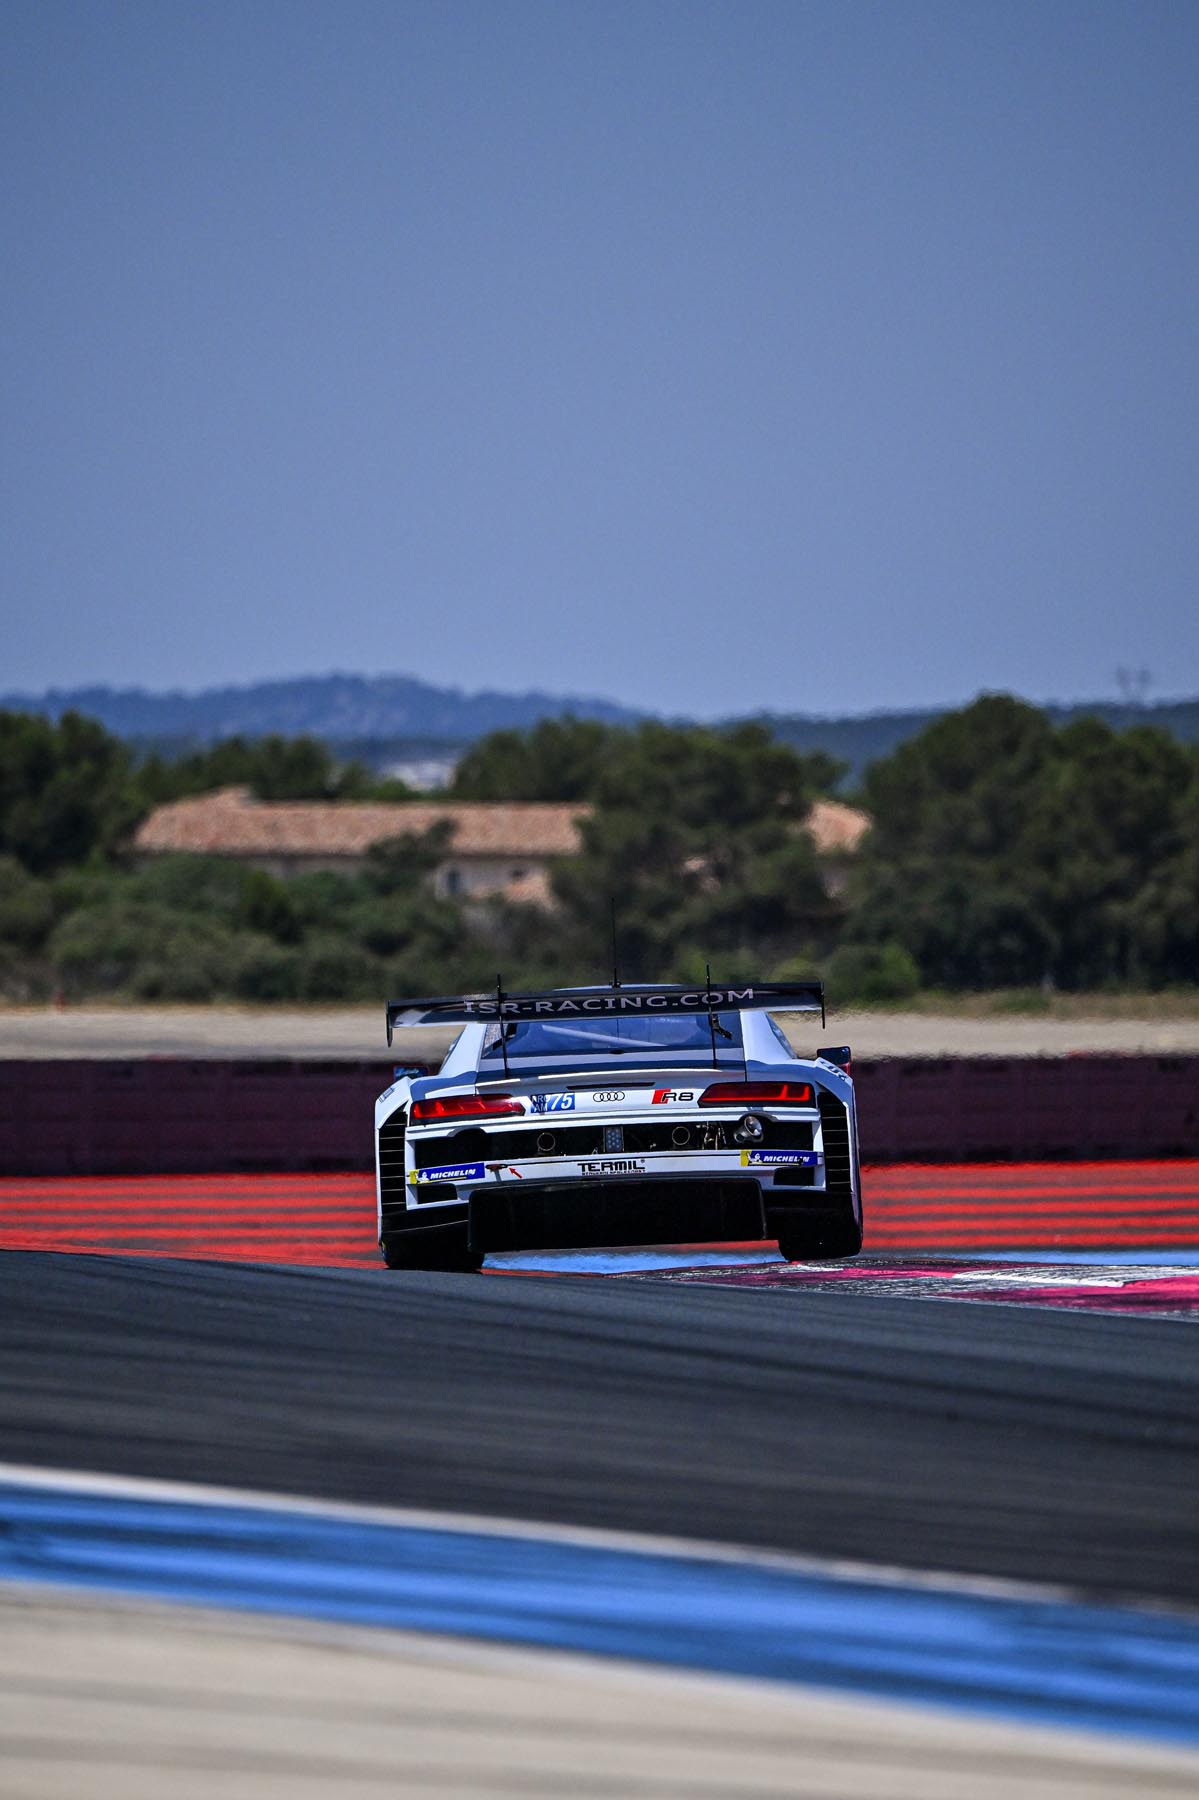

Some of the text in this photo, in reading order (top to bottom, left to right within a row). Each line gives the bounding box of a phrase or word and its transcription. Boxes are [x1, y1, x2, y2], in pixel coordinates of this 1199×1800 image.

[463, 988, 754, 1015] ISR-RACING.COM
[551, 1092, 575, 1110] 75
[661, 1091, 694, 1102] R8
[430, 1168, 477, 1180] MICHELIN
